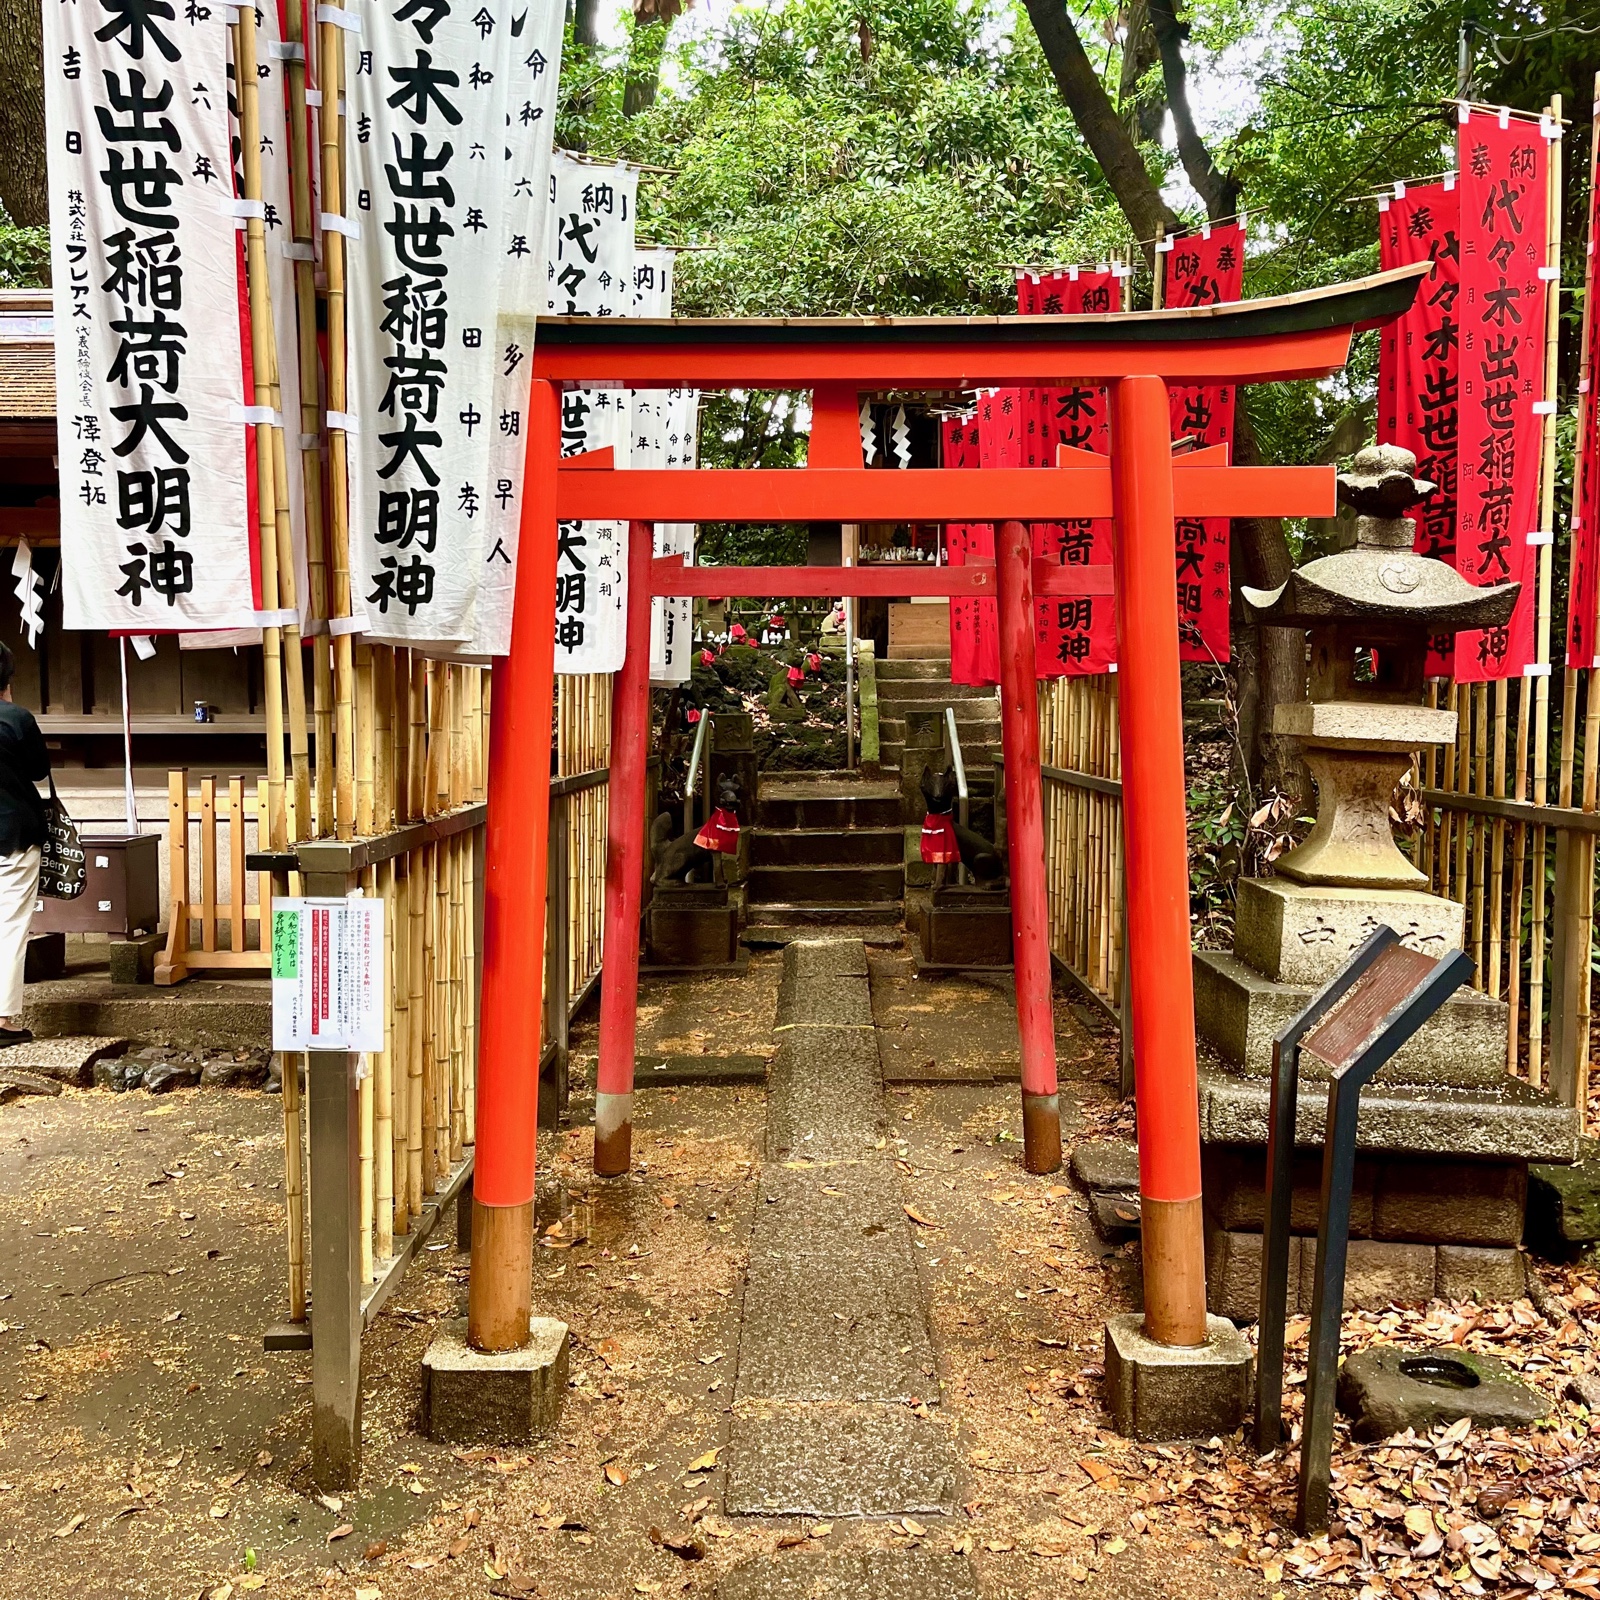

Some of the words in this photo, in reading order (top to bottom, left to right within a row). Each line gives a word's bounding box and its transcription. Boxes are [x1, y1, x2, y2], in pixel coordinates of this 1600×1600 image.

[356, 50, 373, 211] 月吉日
[462, 7, 497, 234] 令和六年
[507, 48, 548, 259] 令和六年
[66, 190, 91, 319] 株式会社フレアス
[94, 0, 194, 606] 木出世稲荷大明神
[1521, 243, 1538, 395] 令和六年
[71, 414, 107, 506] 澤登拓
[457, 328, 483, 518] 田中孝
[487, 343, 524, 564] 多胡早人
[1056, 599, 1093, 663] 明神
[41, 856, 70, 875] Berry
[55, 842, 86, 862] Berry
